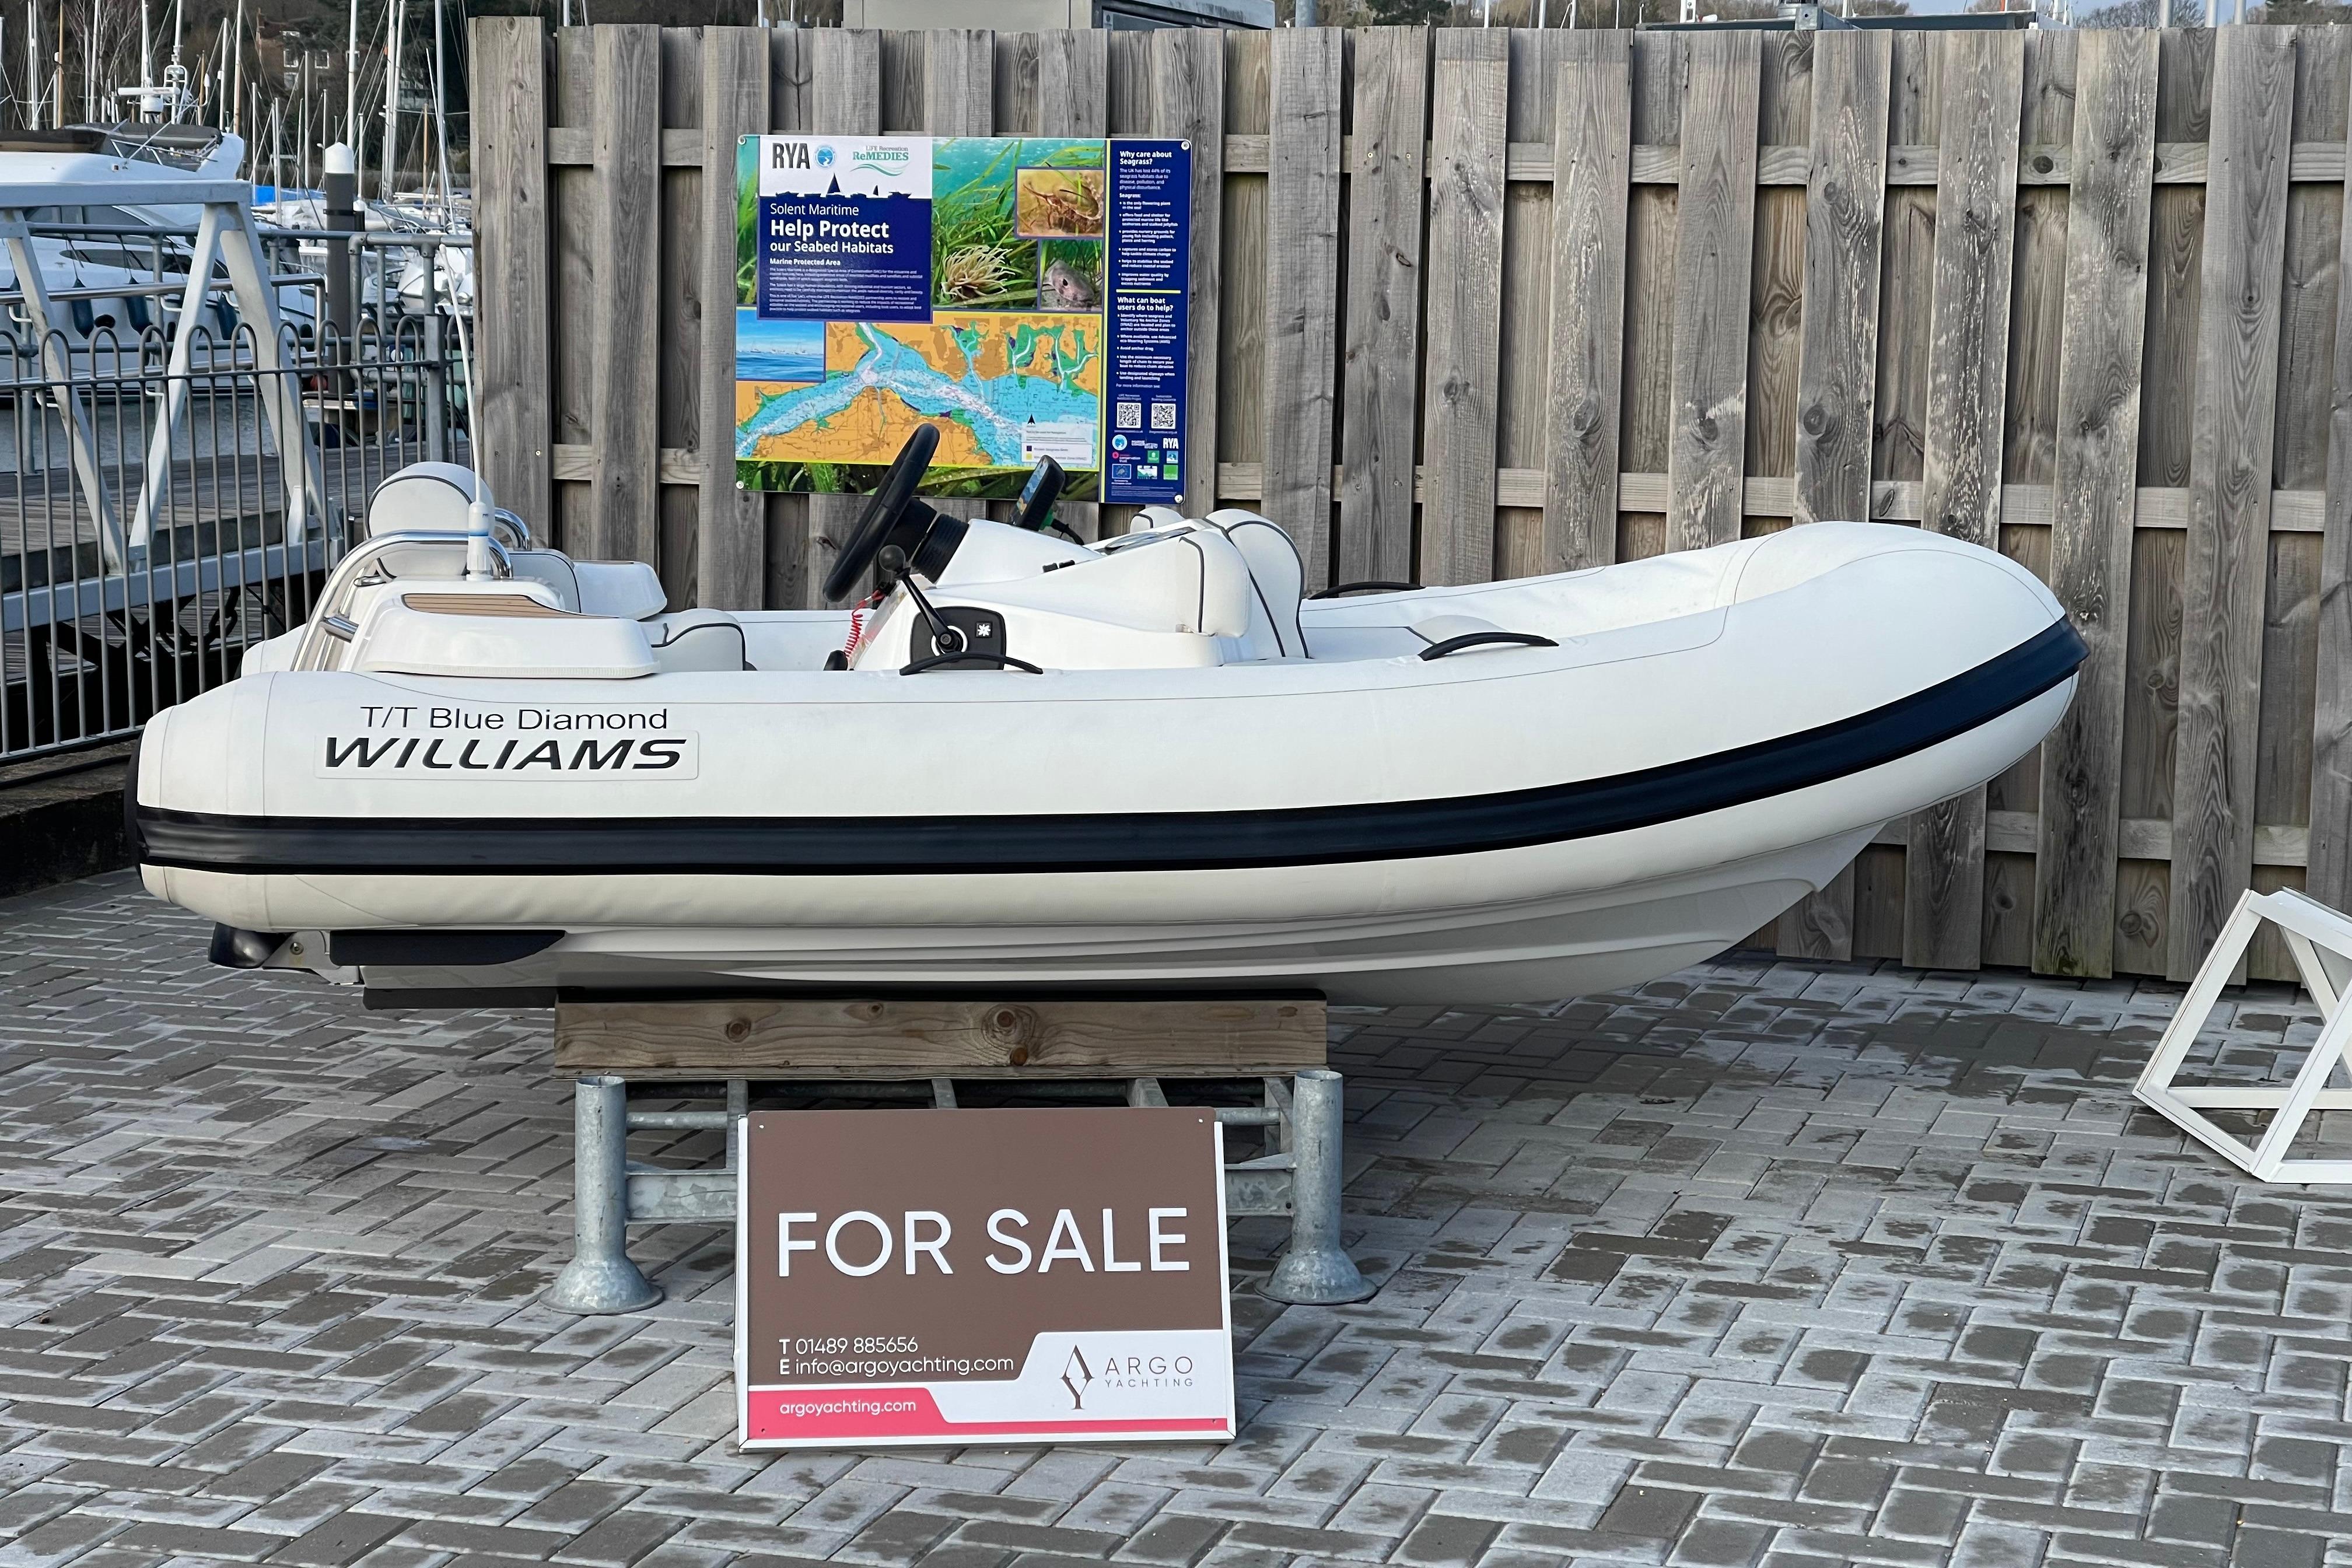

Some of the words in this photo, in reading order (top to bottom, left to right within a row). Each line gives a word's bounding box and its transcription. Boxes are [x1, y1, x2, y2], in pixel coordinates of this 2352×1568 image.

[772, 143, 810, 169] RYA
[853, 152, 908, 160] ReMEDIES
[771, 203, 806, 215] Solent
[809, 204, 859, 215] Maritime
[771, 219, 814, 241] Help
[820, 220, 889, 238] Protect
[770, 242, 791, 252] our
[794, 241, 838, 253] Seabed
[842, 242, 893, 253] Habitats
[1163, 438, 1178, 449] RYA
[360, 706, 418, 727] T/T
[430, 708, 504, 730] Blue
[518, 708, 667, 730] Diamond
[326, 737, 687, 769] WILLIAMS
[778, 1210, 954, 1278] FOR
[985, 1206, 1190, 1275] SALE
[779, 1339, 790, 1354] T
[796, 1338, 848, 1354] 01489
[853, 1337, 918, 1353] 885656
[779, 1359, 790, 1375] E
[796, 1356, 1014, 1377] info@argoyachting.com
[1105, 1356, 1193, 1376] ARGO
[1105, 1378, 1193, 1388] YACHTING
[780, 1399, 916, 1417] argoyachting.com
